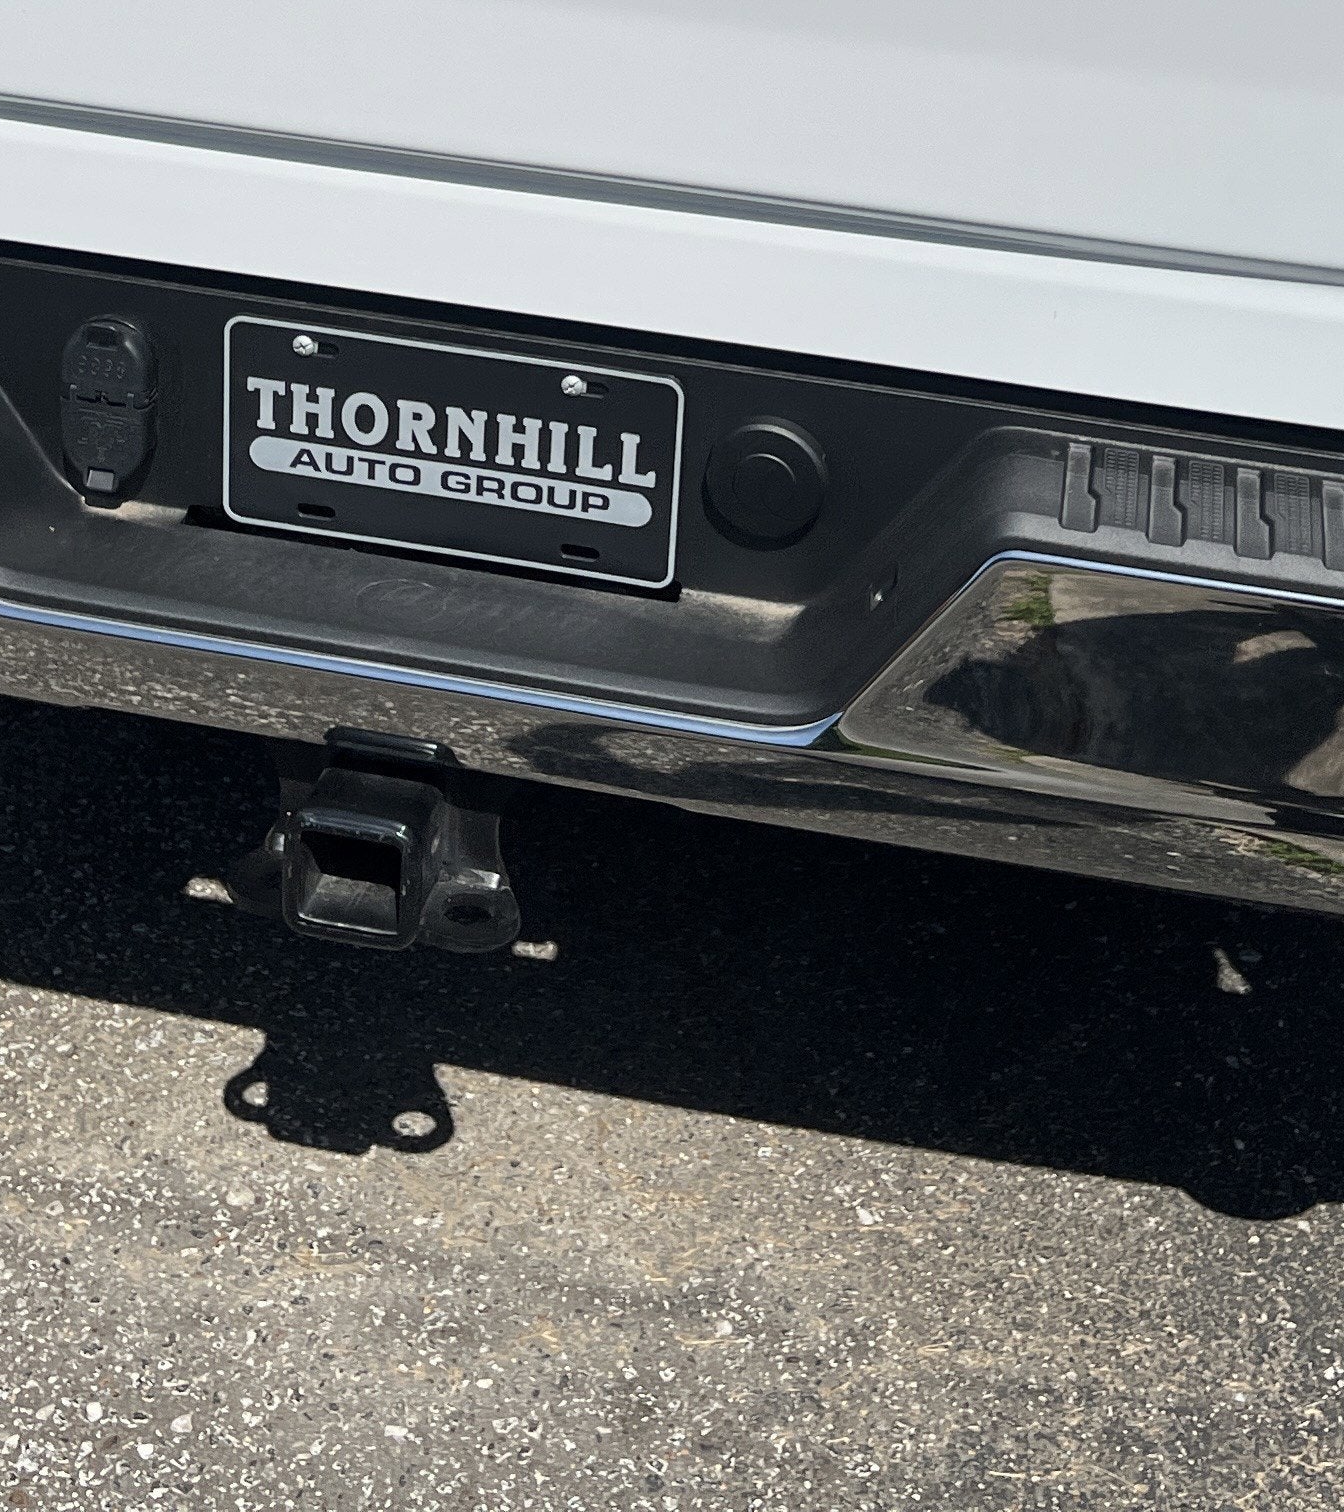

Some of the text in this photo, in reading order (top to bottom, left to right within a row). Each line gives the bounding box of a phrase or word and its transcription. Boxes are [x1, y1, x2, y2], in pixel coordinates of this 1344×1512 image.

[246, 376, 657, 488] THORNHILL
[289, 448, 612, 514] AUTO GROUP
